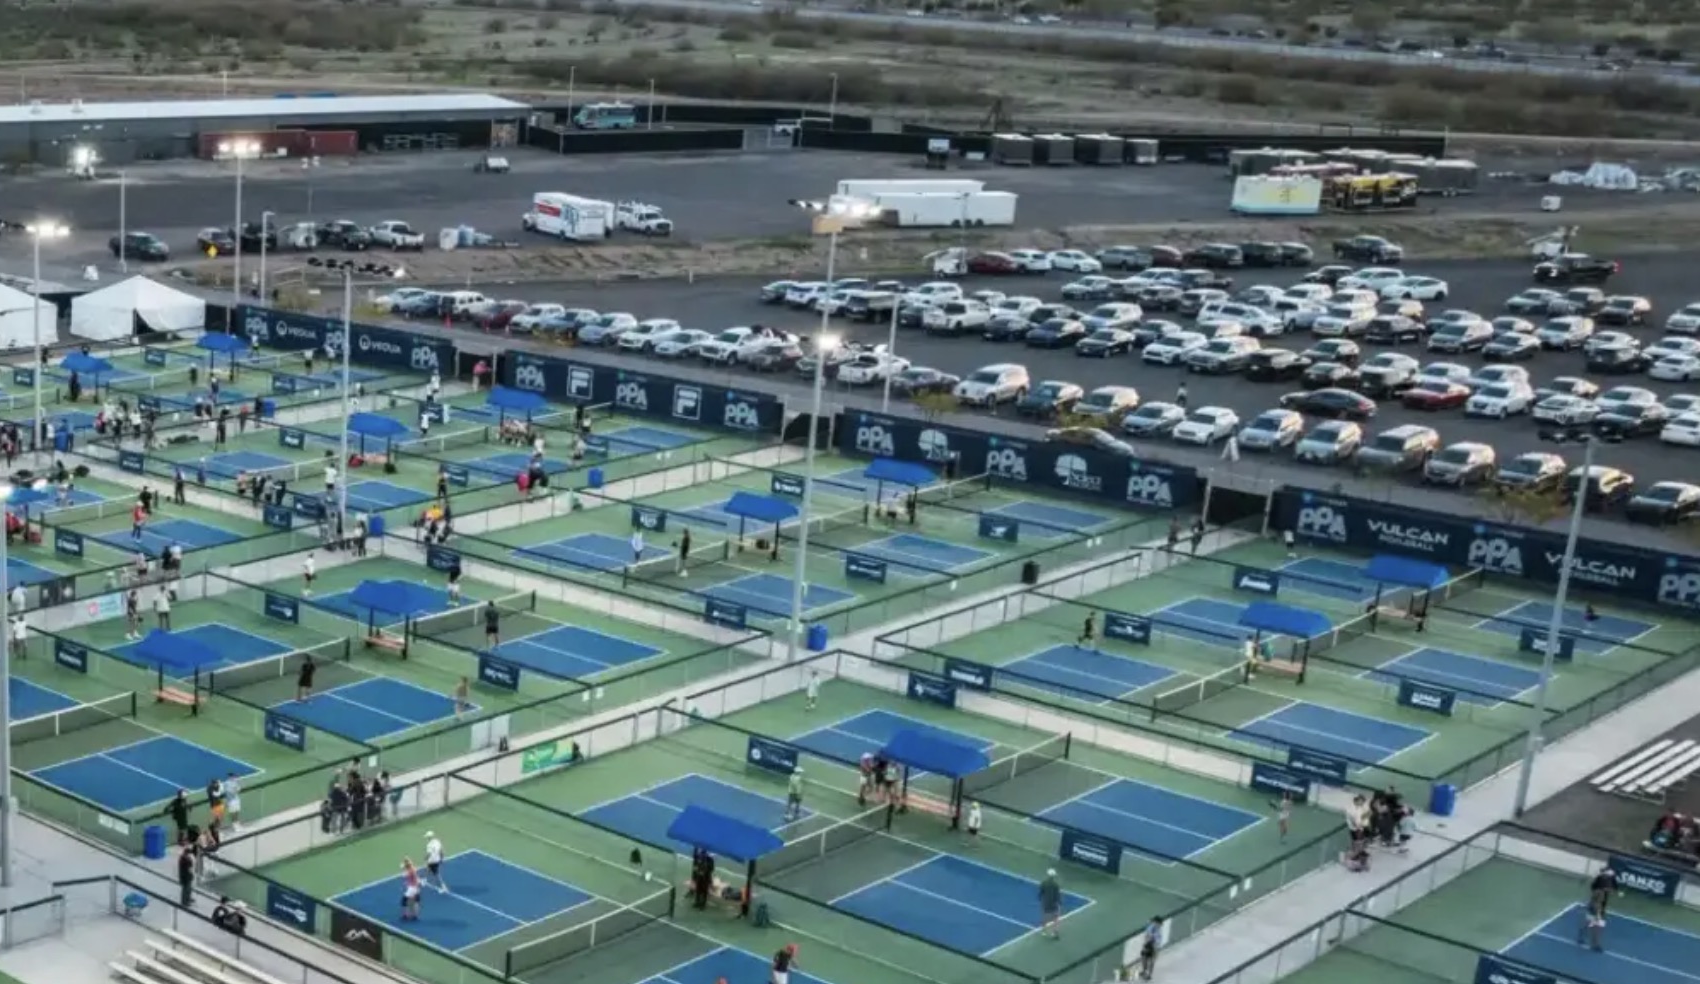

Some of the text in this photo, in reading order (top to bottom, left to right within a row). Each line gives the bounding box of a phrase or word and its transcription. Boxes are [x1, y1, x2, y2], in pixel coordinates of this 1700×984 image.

[245, 316, 269, 339] PPA
[411, 346, 440, 368] PPA
[515, 364, 545, 389] PPA
[615, 381, 648, 406] PPA
[724, 402, 759, 427] PPA
[856, 425, 894, 454] PPA
[986, 448, 1028, 480] PPA
[1127, 474, 1174, 506] PPA
[1299, 505, 1347, 536] PPA
[1366, 518, 1449, 546] VULCAN
[1468, 537, 1523, 571] PPA
[1658, 573, 1700, 602] PP
